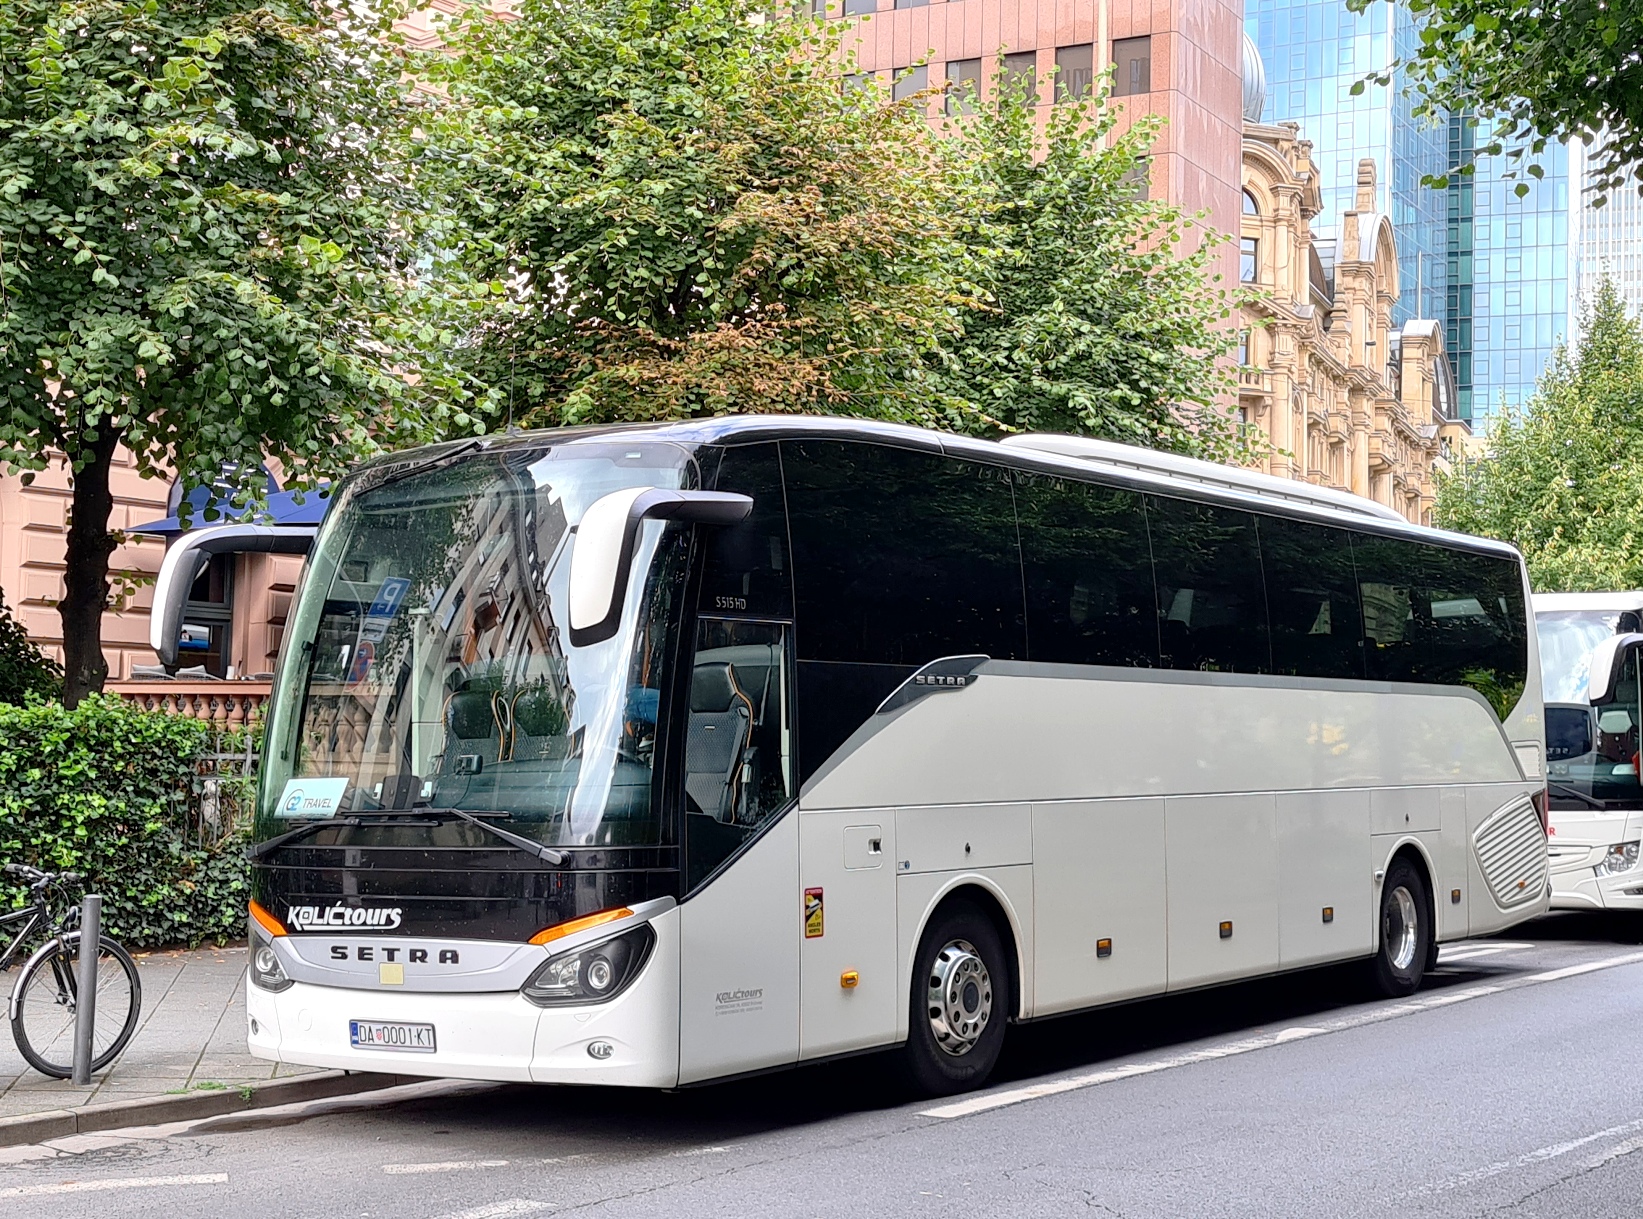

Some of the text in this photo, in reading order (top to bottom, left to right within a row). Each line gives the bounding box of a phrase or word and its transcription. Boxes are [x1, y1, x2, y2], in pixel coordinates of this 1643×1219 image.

[915, 675, 966, 686] SETRA
[303, 798, 332, 809] TRAVEL
[330, 945, 460, 965] SETRA
[359, 1024, 375, 1043] DA
